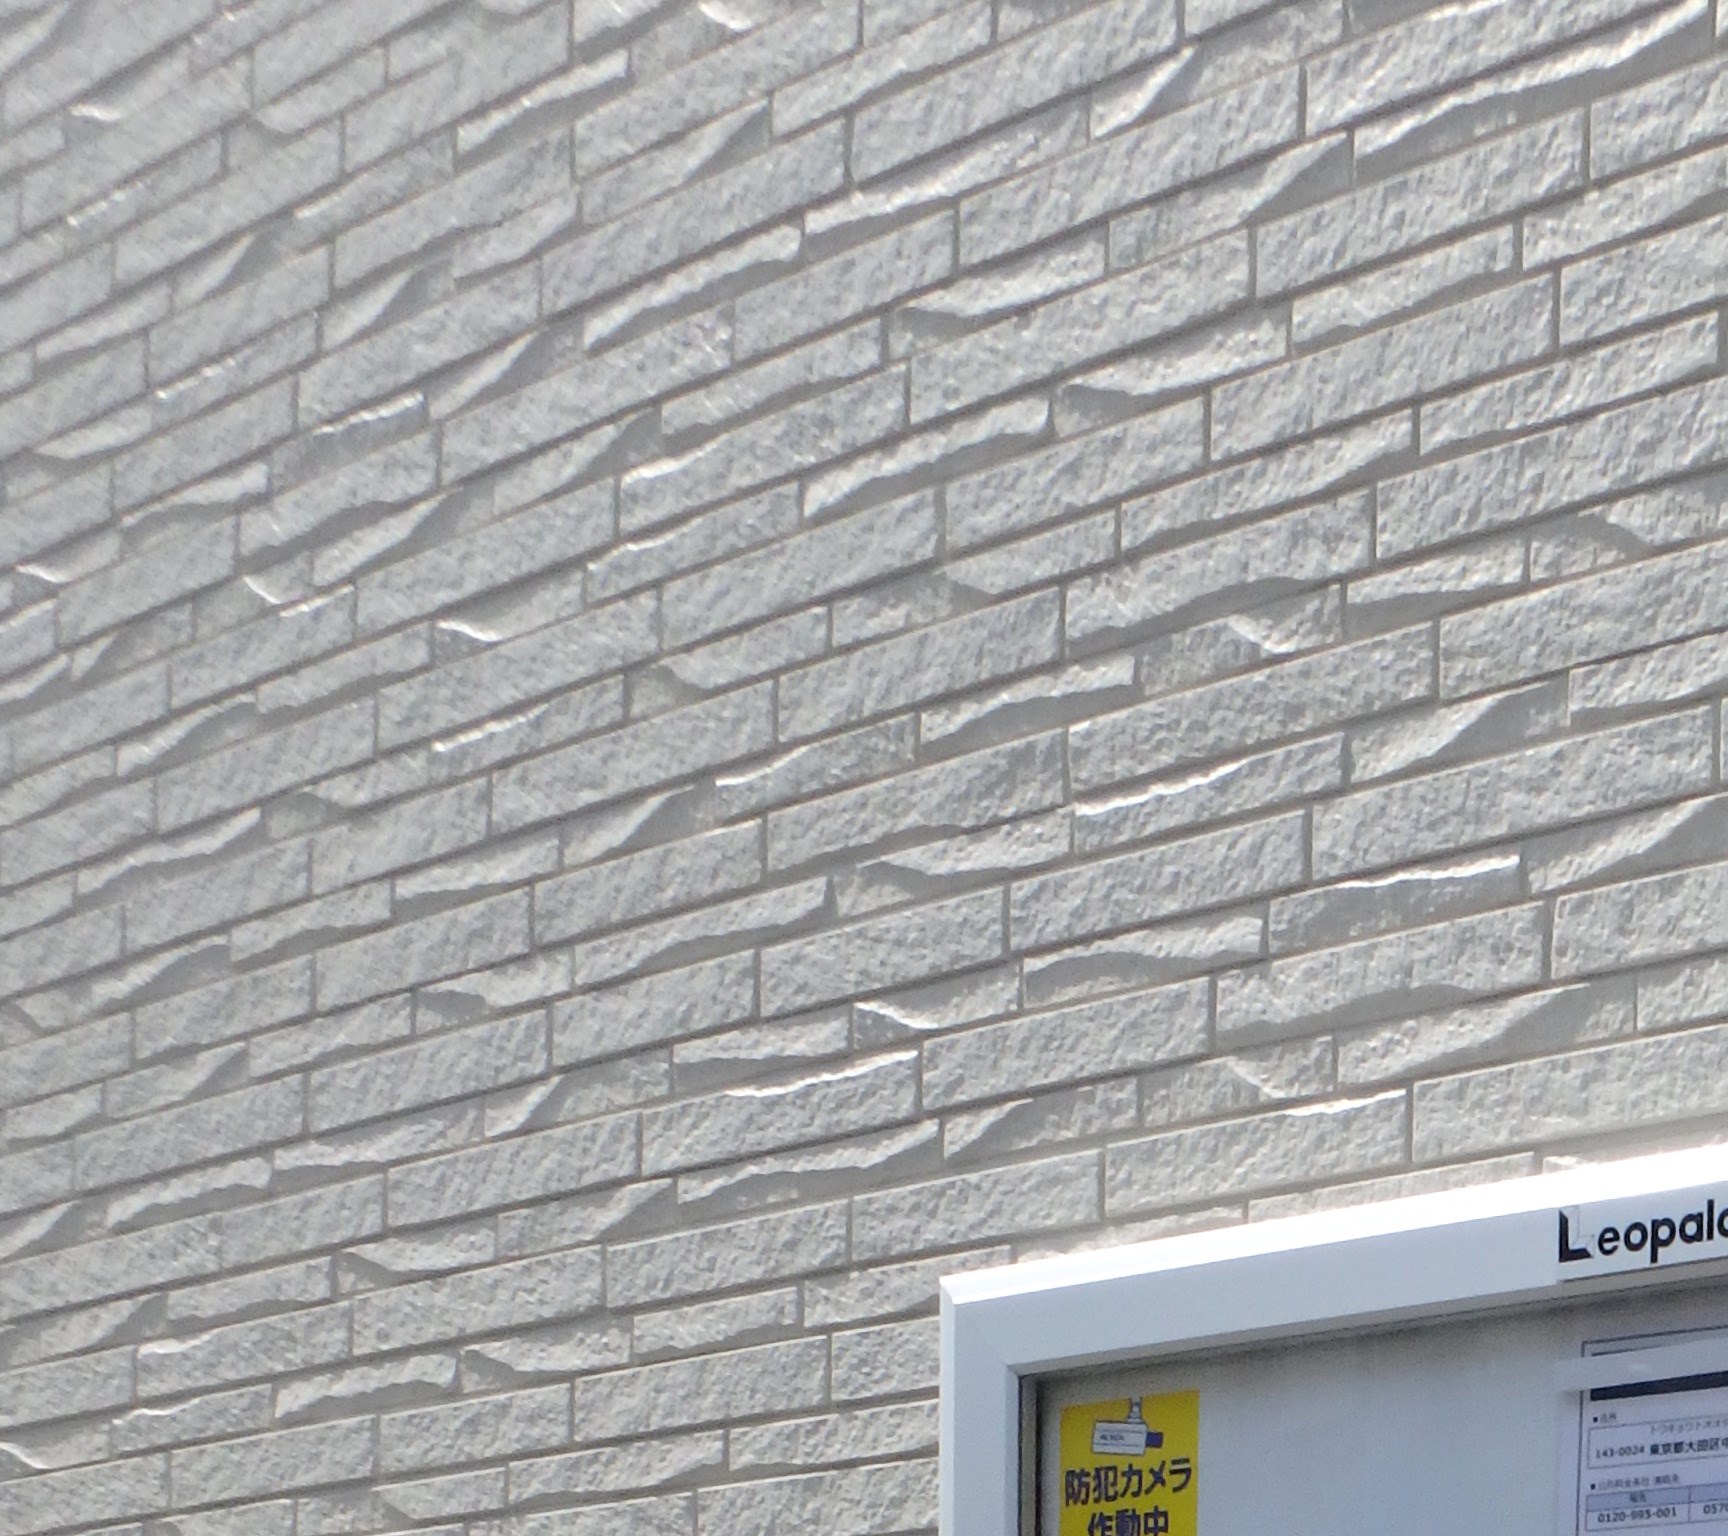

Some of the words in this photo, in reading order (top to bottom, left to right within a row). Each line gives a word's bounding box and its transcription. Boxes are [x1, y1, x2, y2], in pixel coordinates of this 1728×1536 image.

[1065, 1458, 1192, 1507] 防犯カメラ
[1598, 1507, 1677, 1523] 0120-995-001
